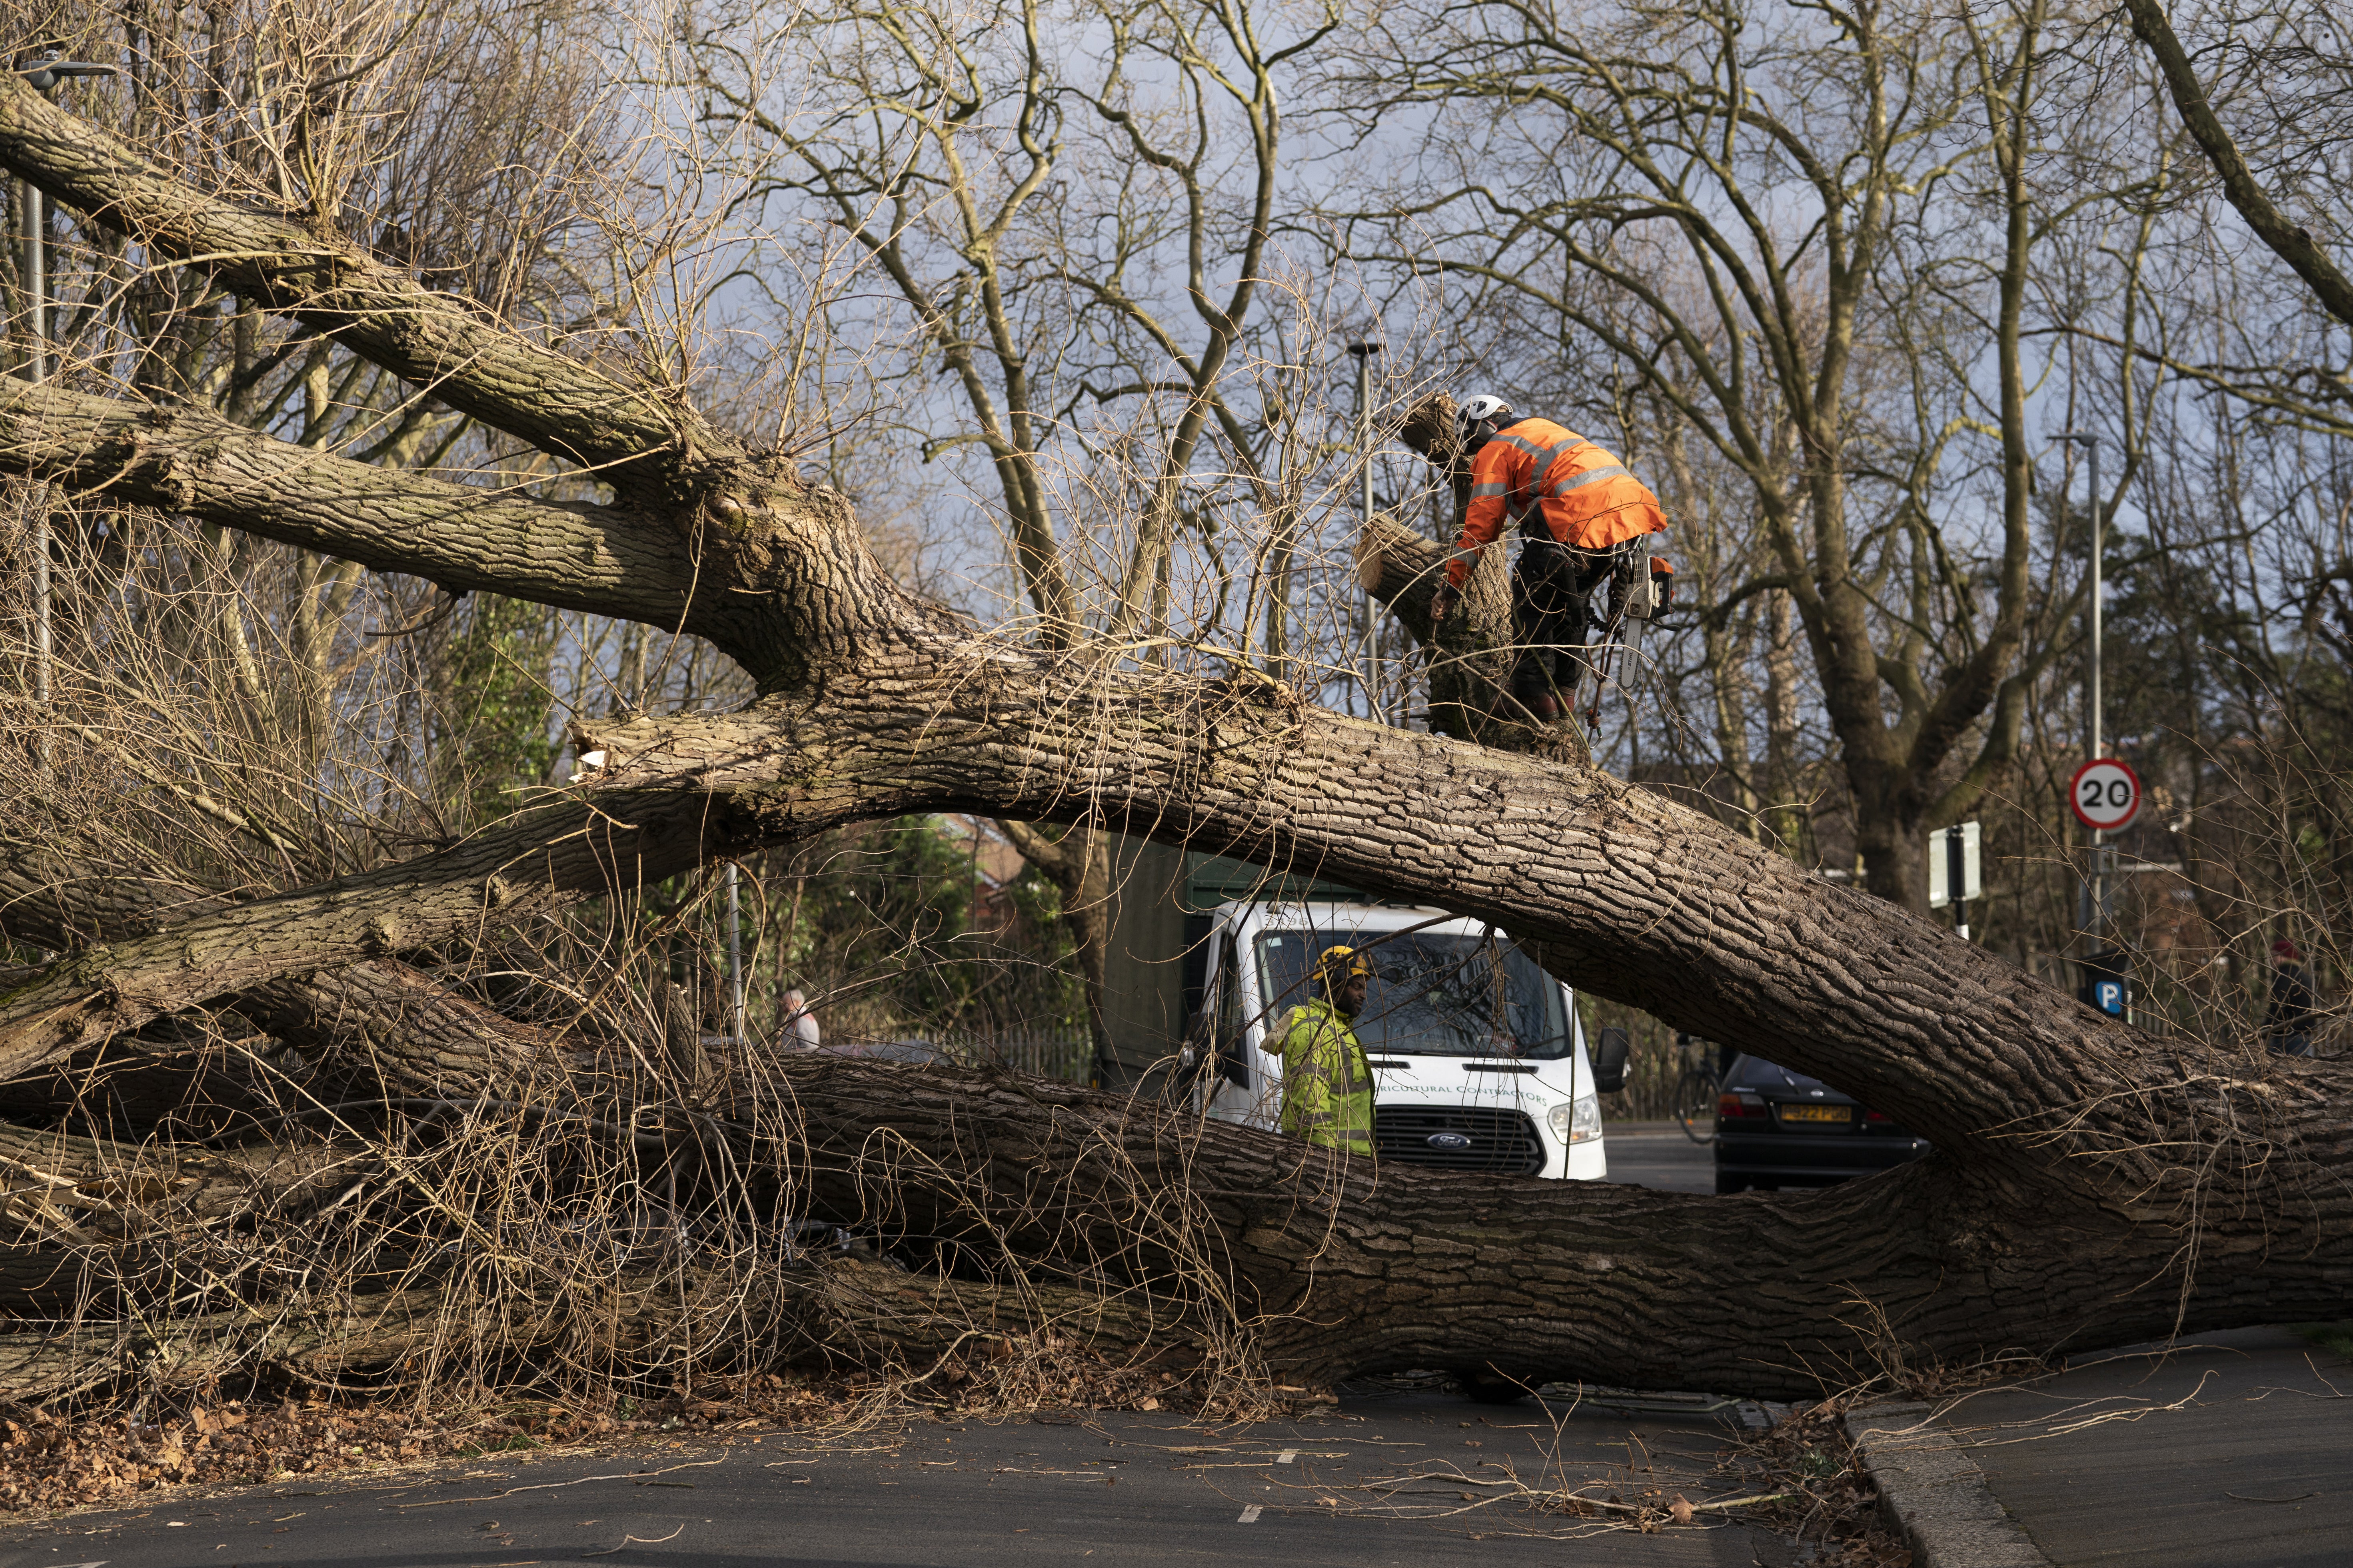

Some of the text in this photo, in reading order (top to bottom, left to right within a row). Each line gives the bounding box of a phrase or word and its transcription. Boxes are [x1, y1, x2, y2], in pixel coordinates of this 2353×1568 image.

[2083, 780, 2129, 808] 20
[2102, 984, 2118, 1008] P
[1437, 1135, 1461, 1146] Ford
